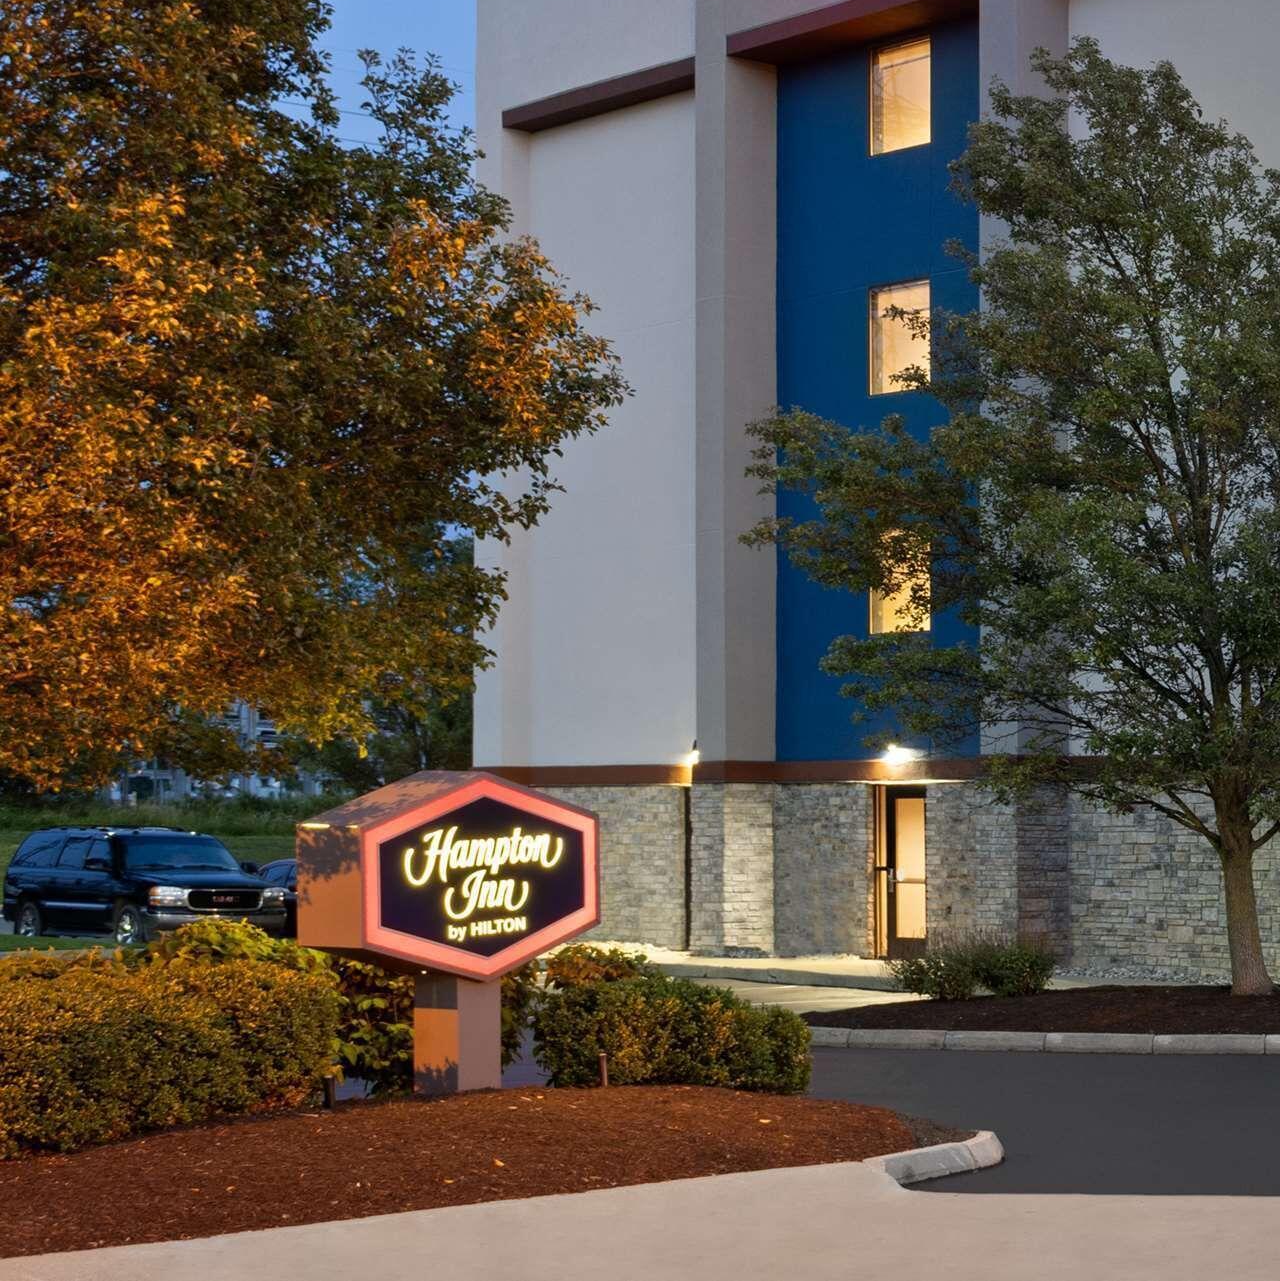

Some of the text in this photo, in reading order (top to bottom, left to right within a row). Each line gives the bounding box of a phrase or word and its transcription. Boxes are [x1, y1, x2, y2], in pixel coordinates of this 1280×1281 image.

[405, 826, 563, 885] Hampton
[444, 870, 528, 919] Inn
[448, 917, 526, 942] by HILTON
